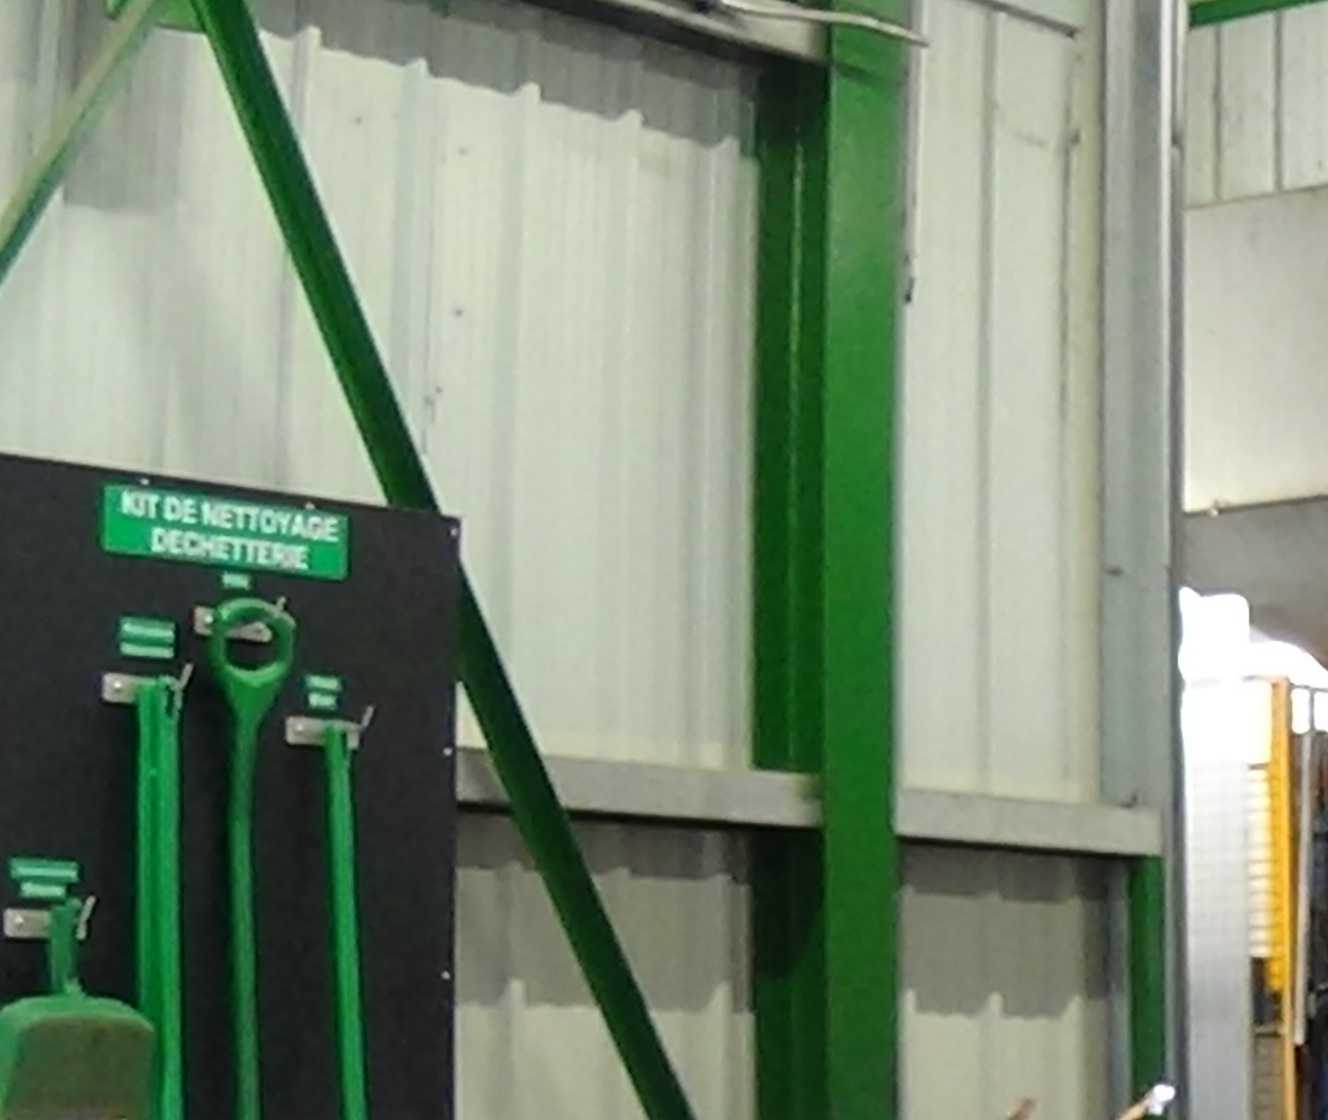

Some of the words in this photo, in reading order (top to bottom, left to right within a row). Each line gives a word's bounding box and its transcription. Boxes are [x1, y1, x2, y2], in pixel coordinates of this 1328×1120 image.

[121, 489, 159, 519] KIT
[162, 496, 197, 524] DE
[202, 502, 339, 542] NETTOYAGE
[152, 528, 309, 569] DECHETTERIE
